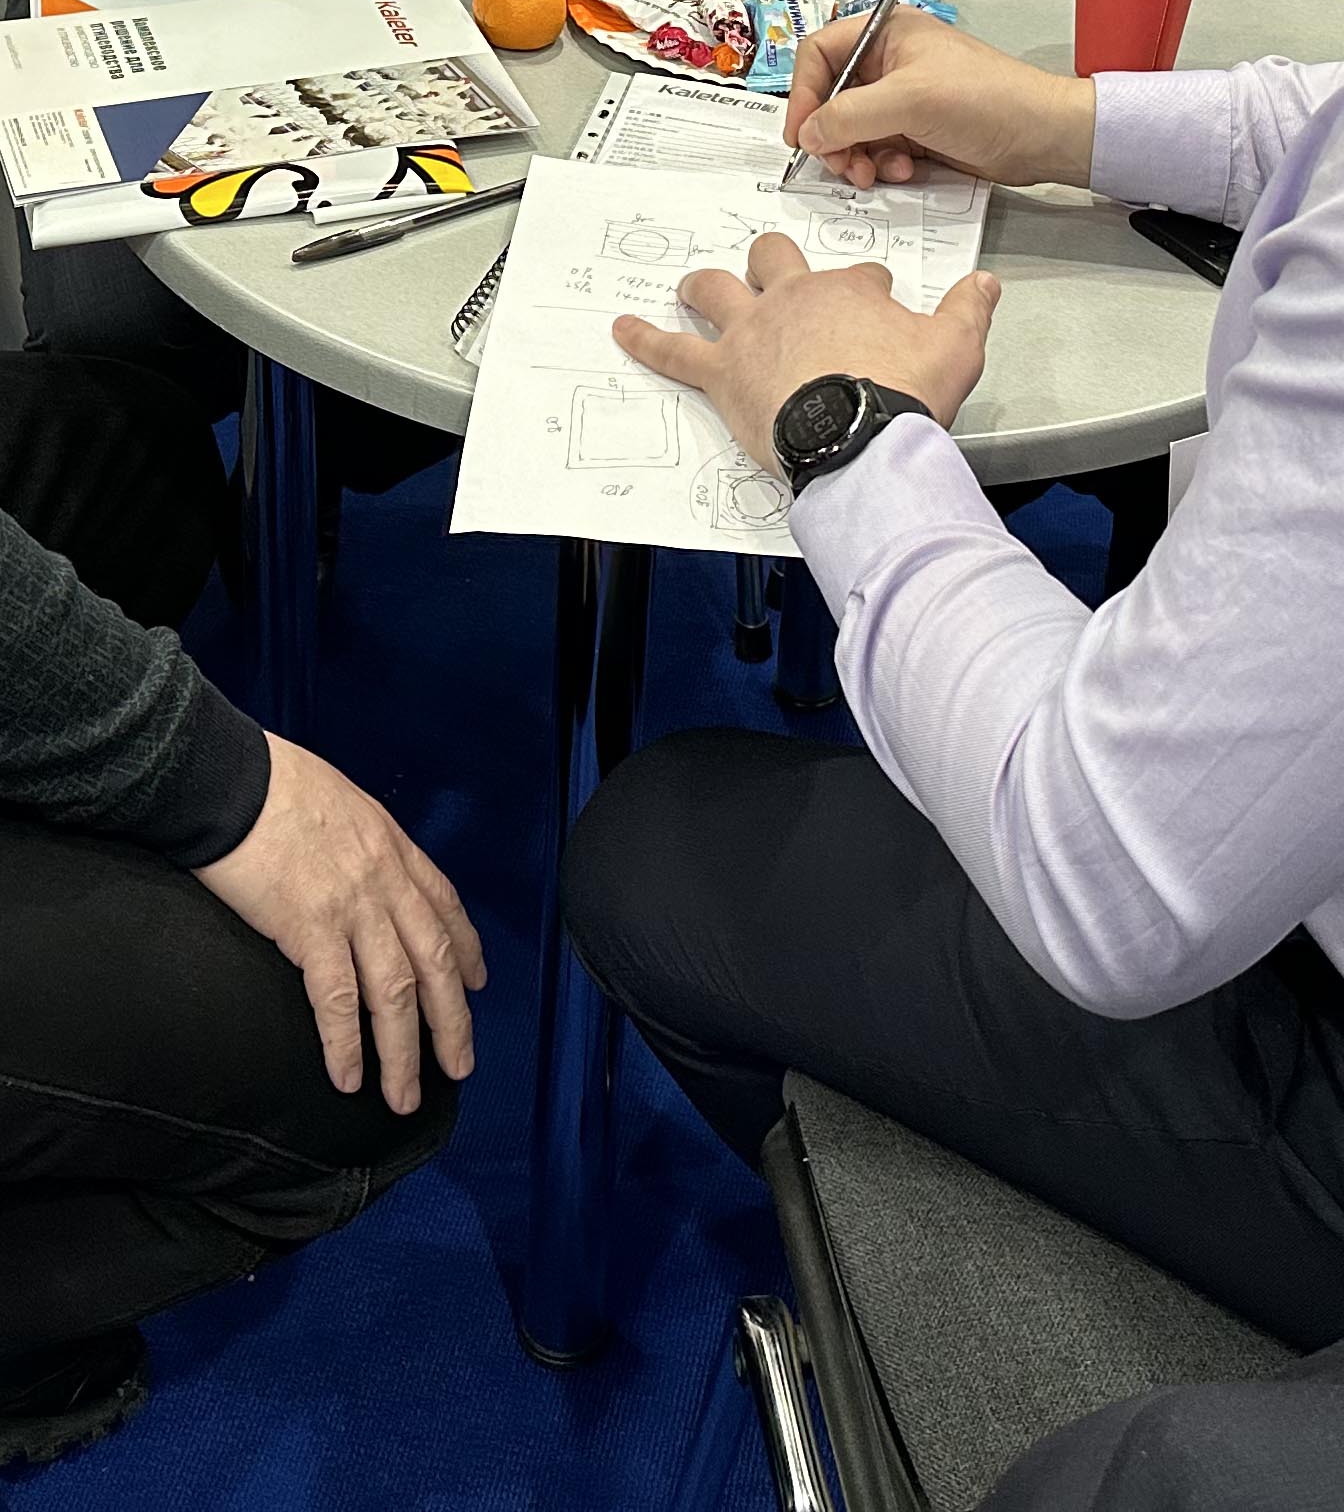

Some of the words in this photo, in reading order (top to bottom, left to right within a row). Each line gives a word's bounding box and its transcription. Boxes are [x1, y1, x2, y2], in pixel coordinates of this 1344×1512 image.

[374, 1, 418, 47] Kaleter
[658, 84, 745, 107] Kaleter
[802, 393, 838, 440] 13:02
